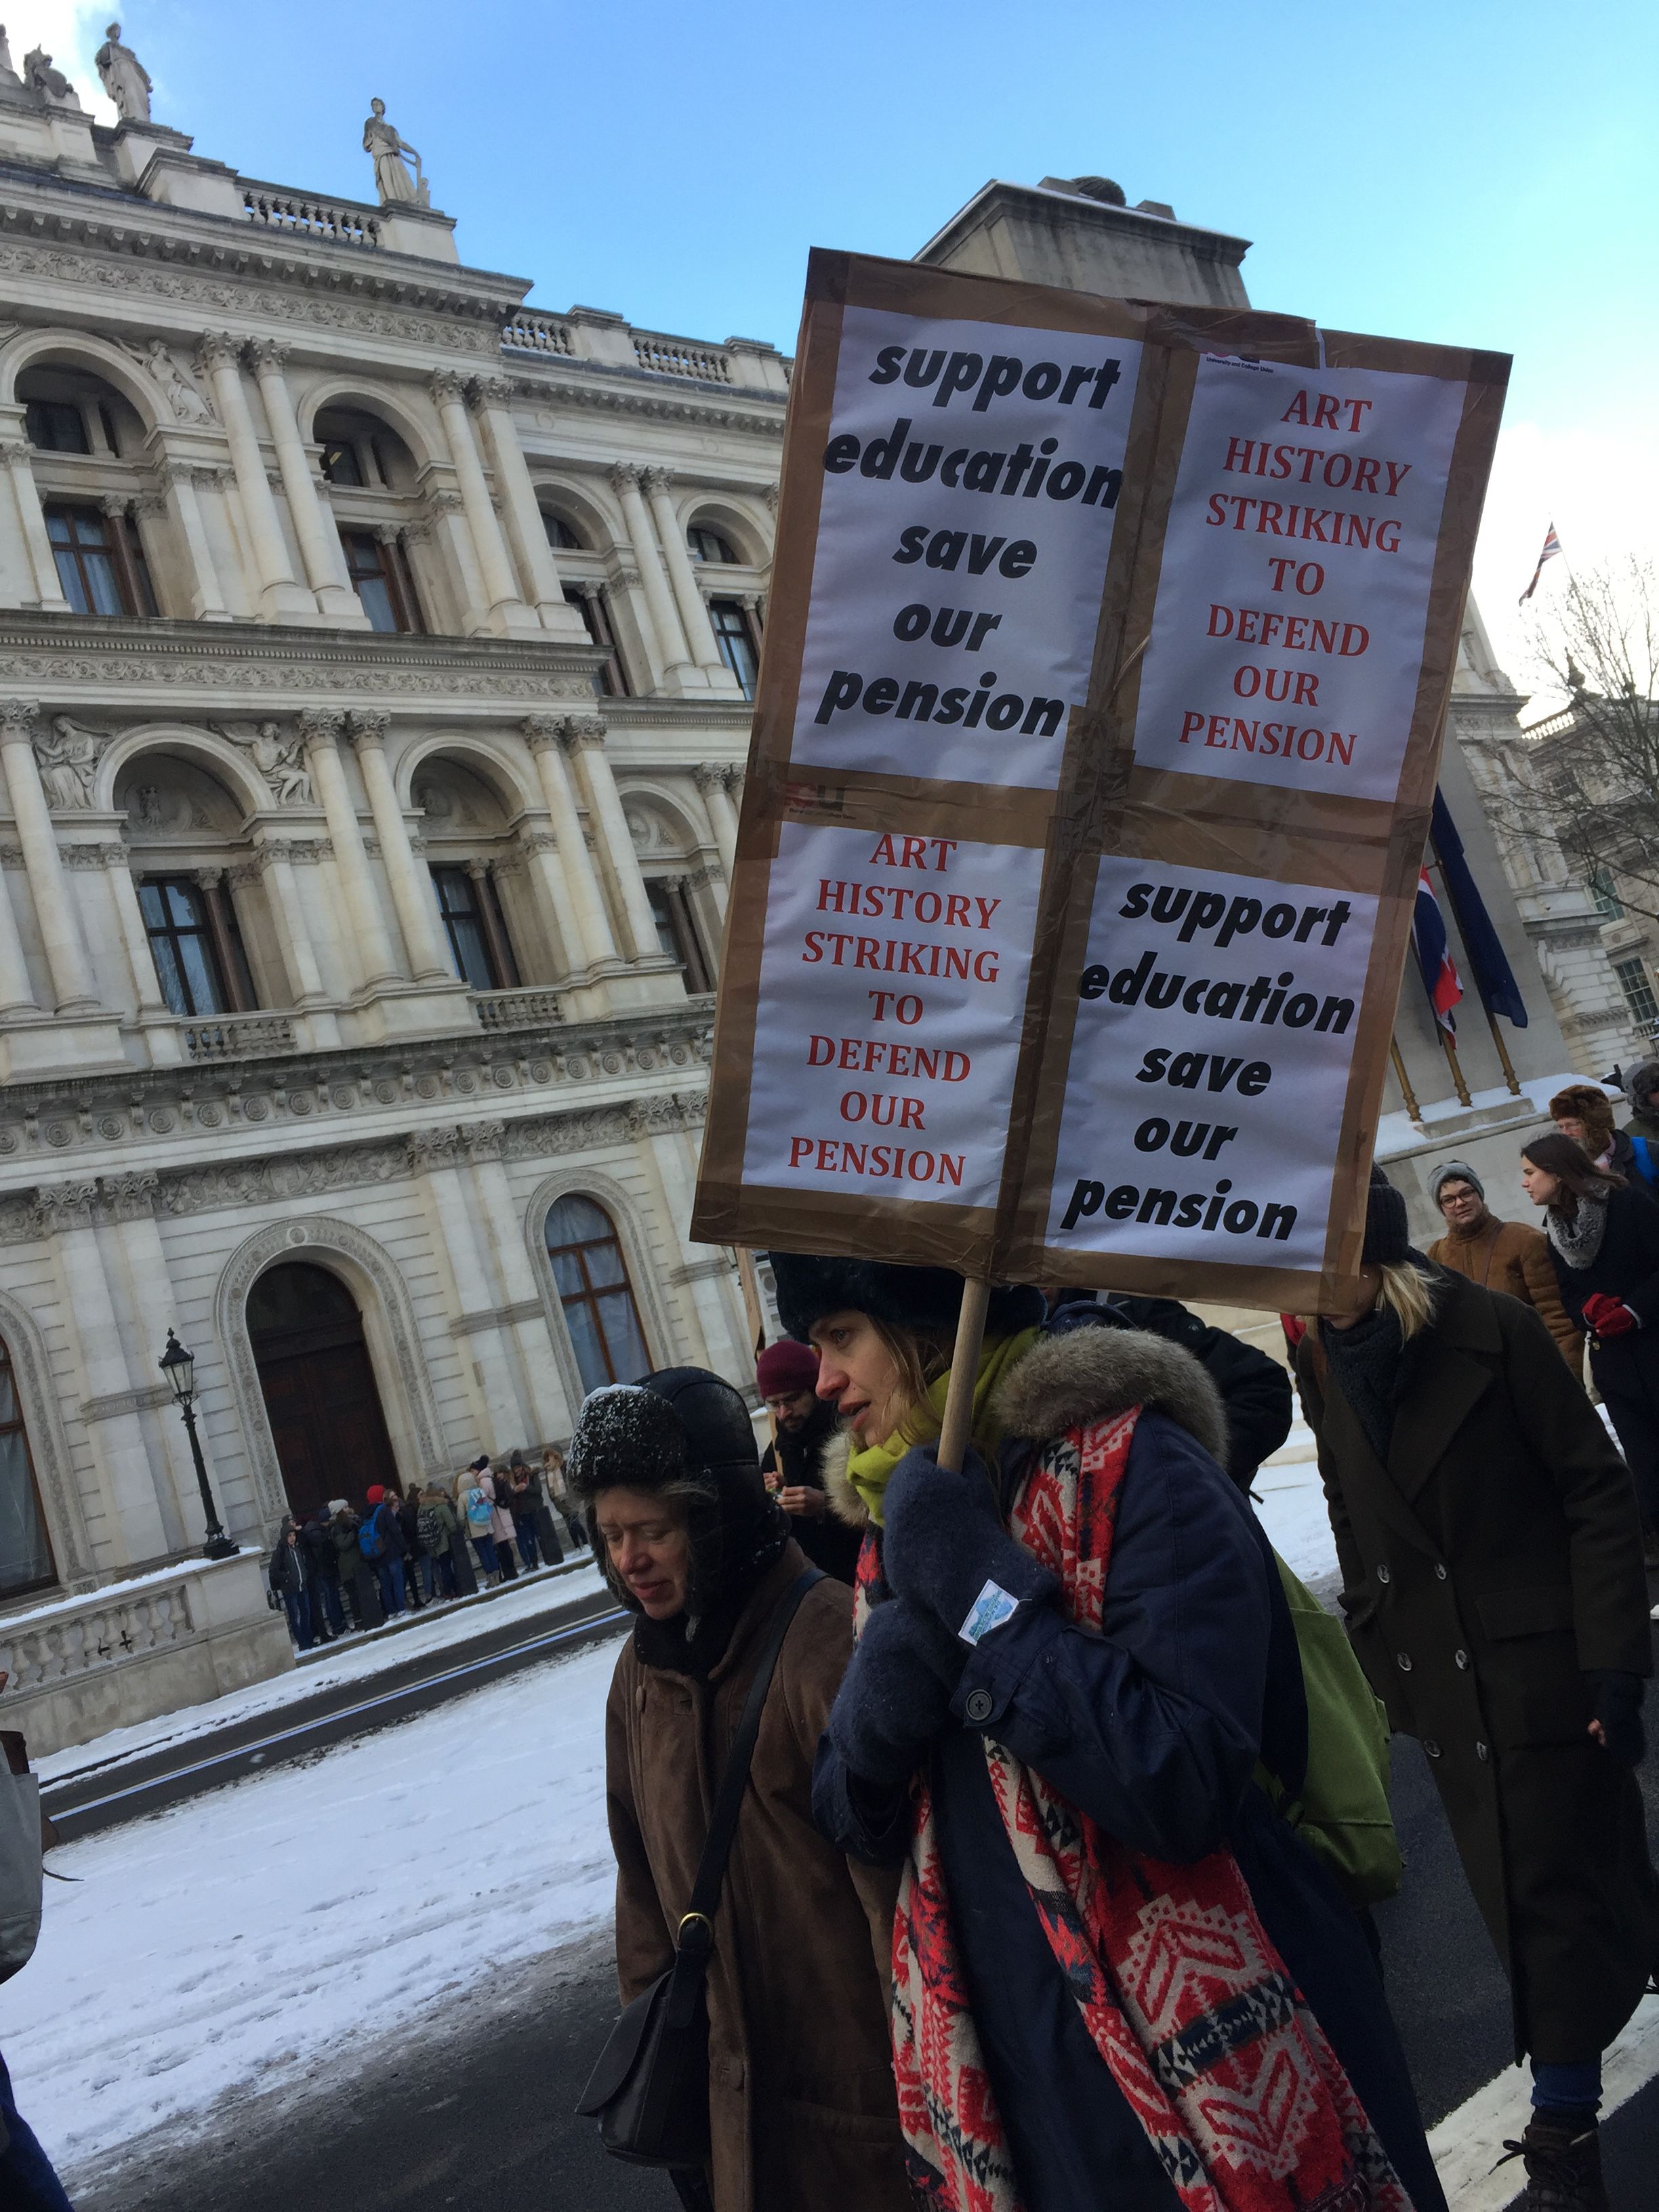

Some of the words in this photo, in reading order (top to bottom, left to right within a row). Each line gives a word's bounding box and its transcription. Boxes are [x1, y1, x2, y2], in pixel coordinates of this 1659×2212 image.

[868, 346, 1120, 412] support
[1206, 356, 1231, 365] University
[1241, 363, 1260, 371] College
[1281, 390, 1372, 433] ART
[821, 419, 1123, 509] education
[1223, 436, 1412, 497] HISTORY
[1206, 493, 1401, 552] STRIKING
[892, 526, 1037, 578] save
[1268, 557, 1324, 596] TO
[894, 604, 1002, 652] our
[1206, 605, 1368, 655] DEFEND
[815, 671, 1064, 737] pension
[1233, 665, 1320, 706] OUR
[1179, 712, 1357, 765] PENSION
[869, 834, 959, 871] ART
[817, 879, 1002, 929] HISTORY
[1118, 884, 1351, 947] support
[802, 932, 1000, 982] STRIKING
[868, 990, 923, 1025] TO
[1080, 951, 1355, 1034] education
[806, 1036, 971, 1082] DEFEND
[1135, 1048, 1271, 1096] save
[840, 1092, 926, 1130] OUR
[787, 1137, 965, 1186] PENSION
[1134, 1118, 1239, 1160] our
[1060, 1179, 1297, 1240] pension
